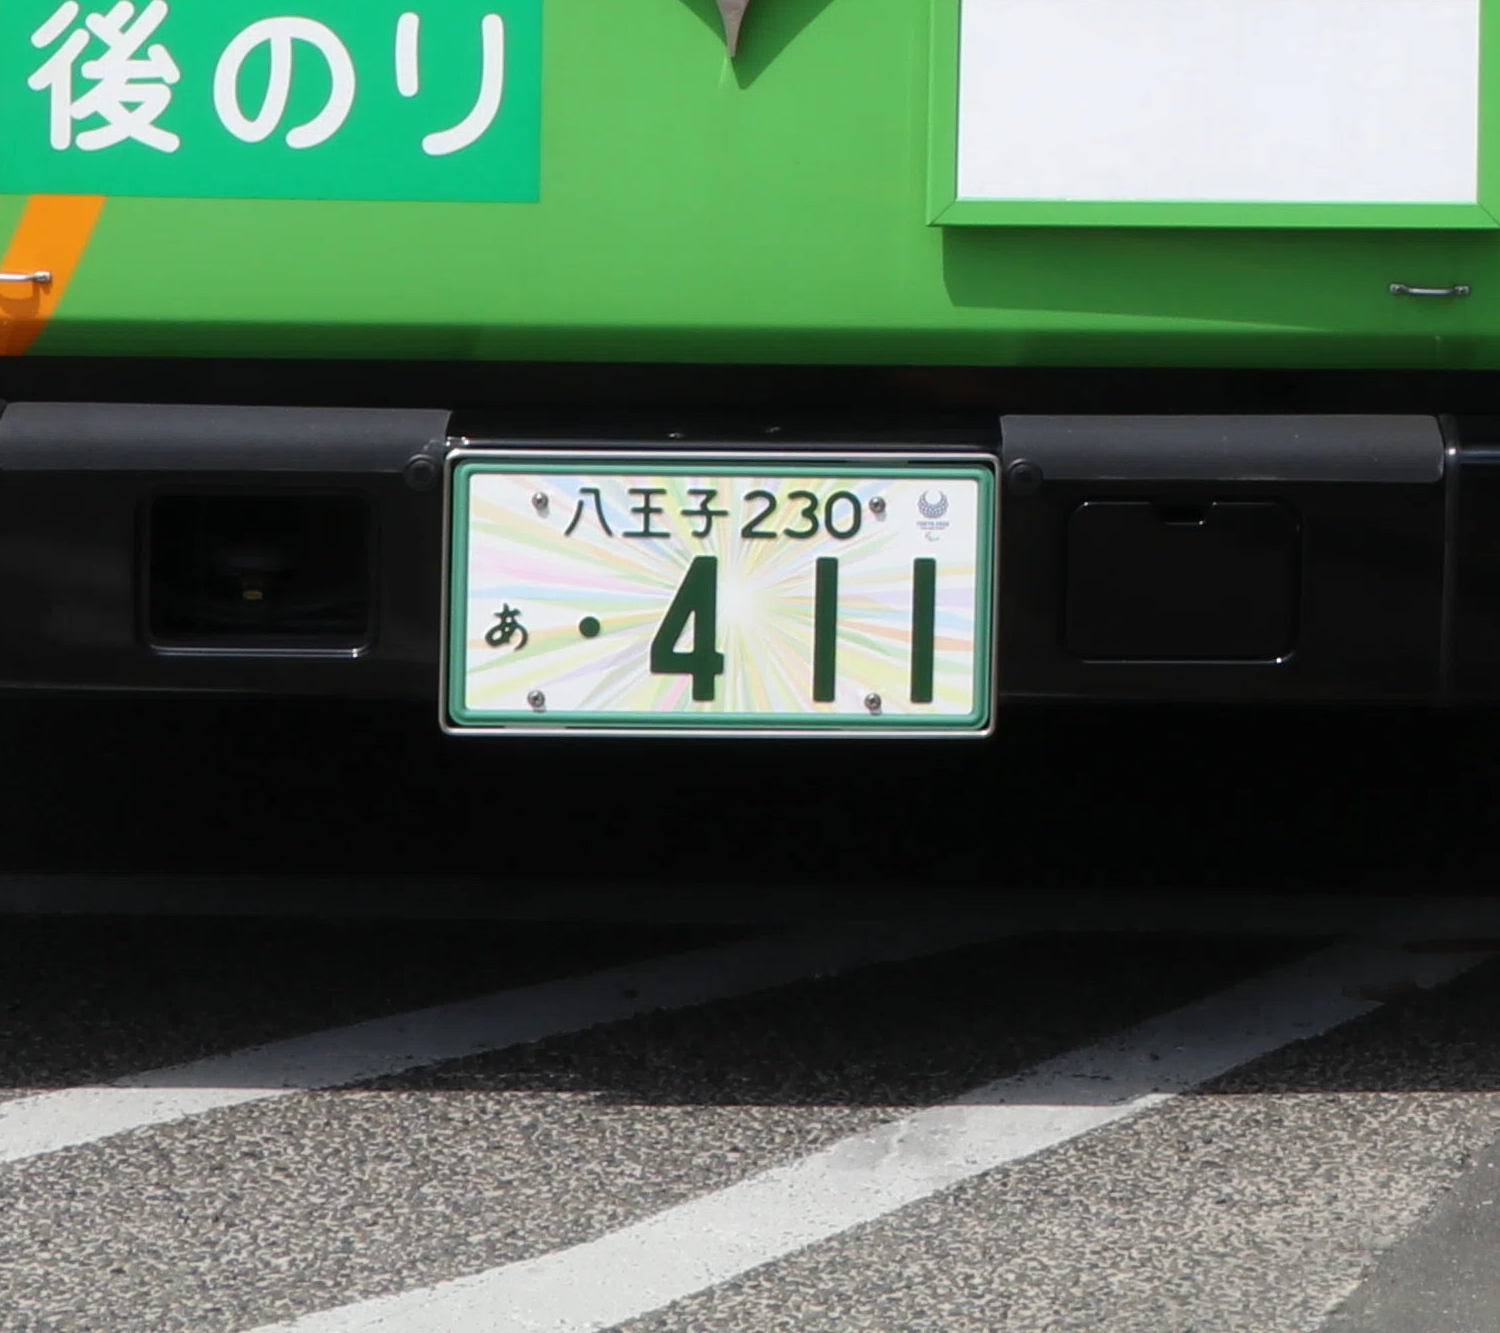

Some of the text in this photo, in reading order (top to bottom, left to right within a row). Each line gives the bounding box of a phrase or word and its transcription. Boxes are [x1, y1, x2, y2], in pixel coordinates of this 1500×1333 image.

[565, 487, 862, 539] 八王子 230
[484, 602, 529, 652] あ
